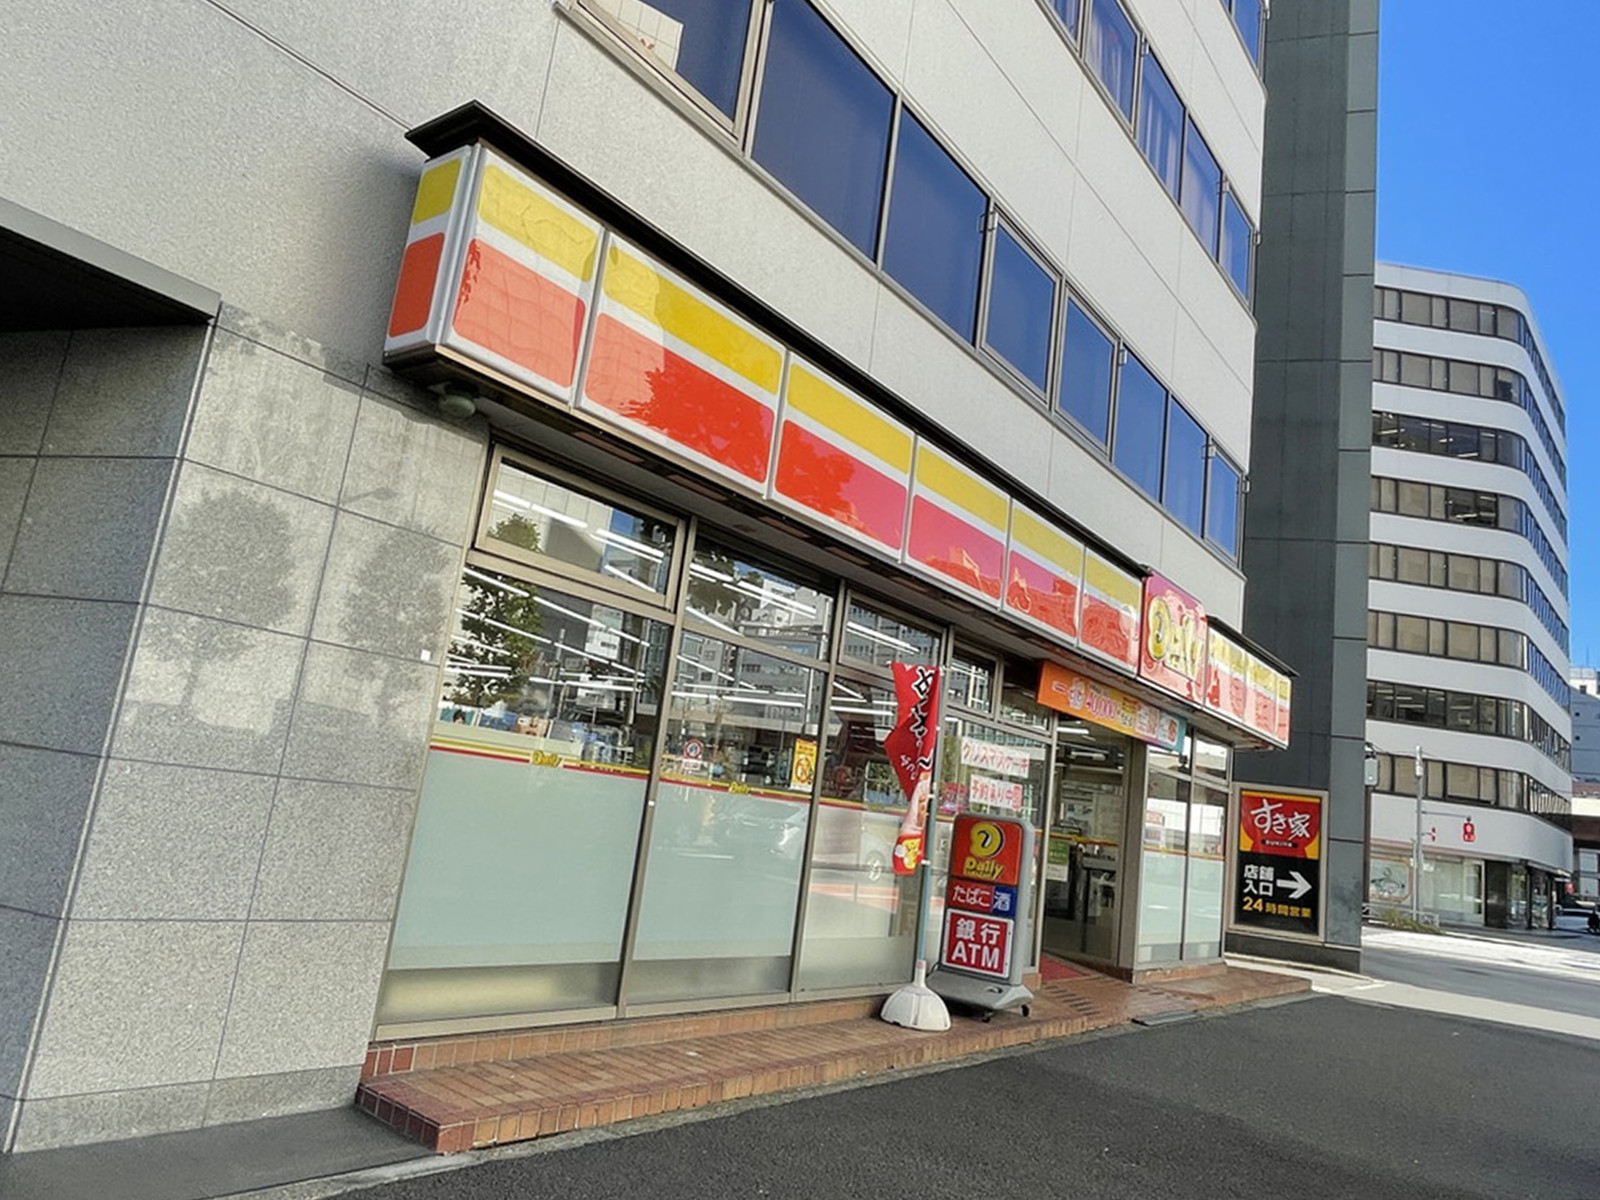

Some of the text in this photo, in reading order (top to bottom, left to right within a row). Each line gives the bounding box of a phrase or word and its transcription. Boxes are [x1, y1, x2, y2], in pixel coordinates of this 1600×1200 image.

[1250, 798, 1311, 841] すき家
[1243, 863, 1275, 882] 店舗
[952, 884, 1012, 912] たばこ 酒
[1243, 880, 1274, 897] 入口
[955, 917, 1001, 946] 銀行
[951, 940, 1001, 970] ATM
